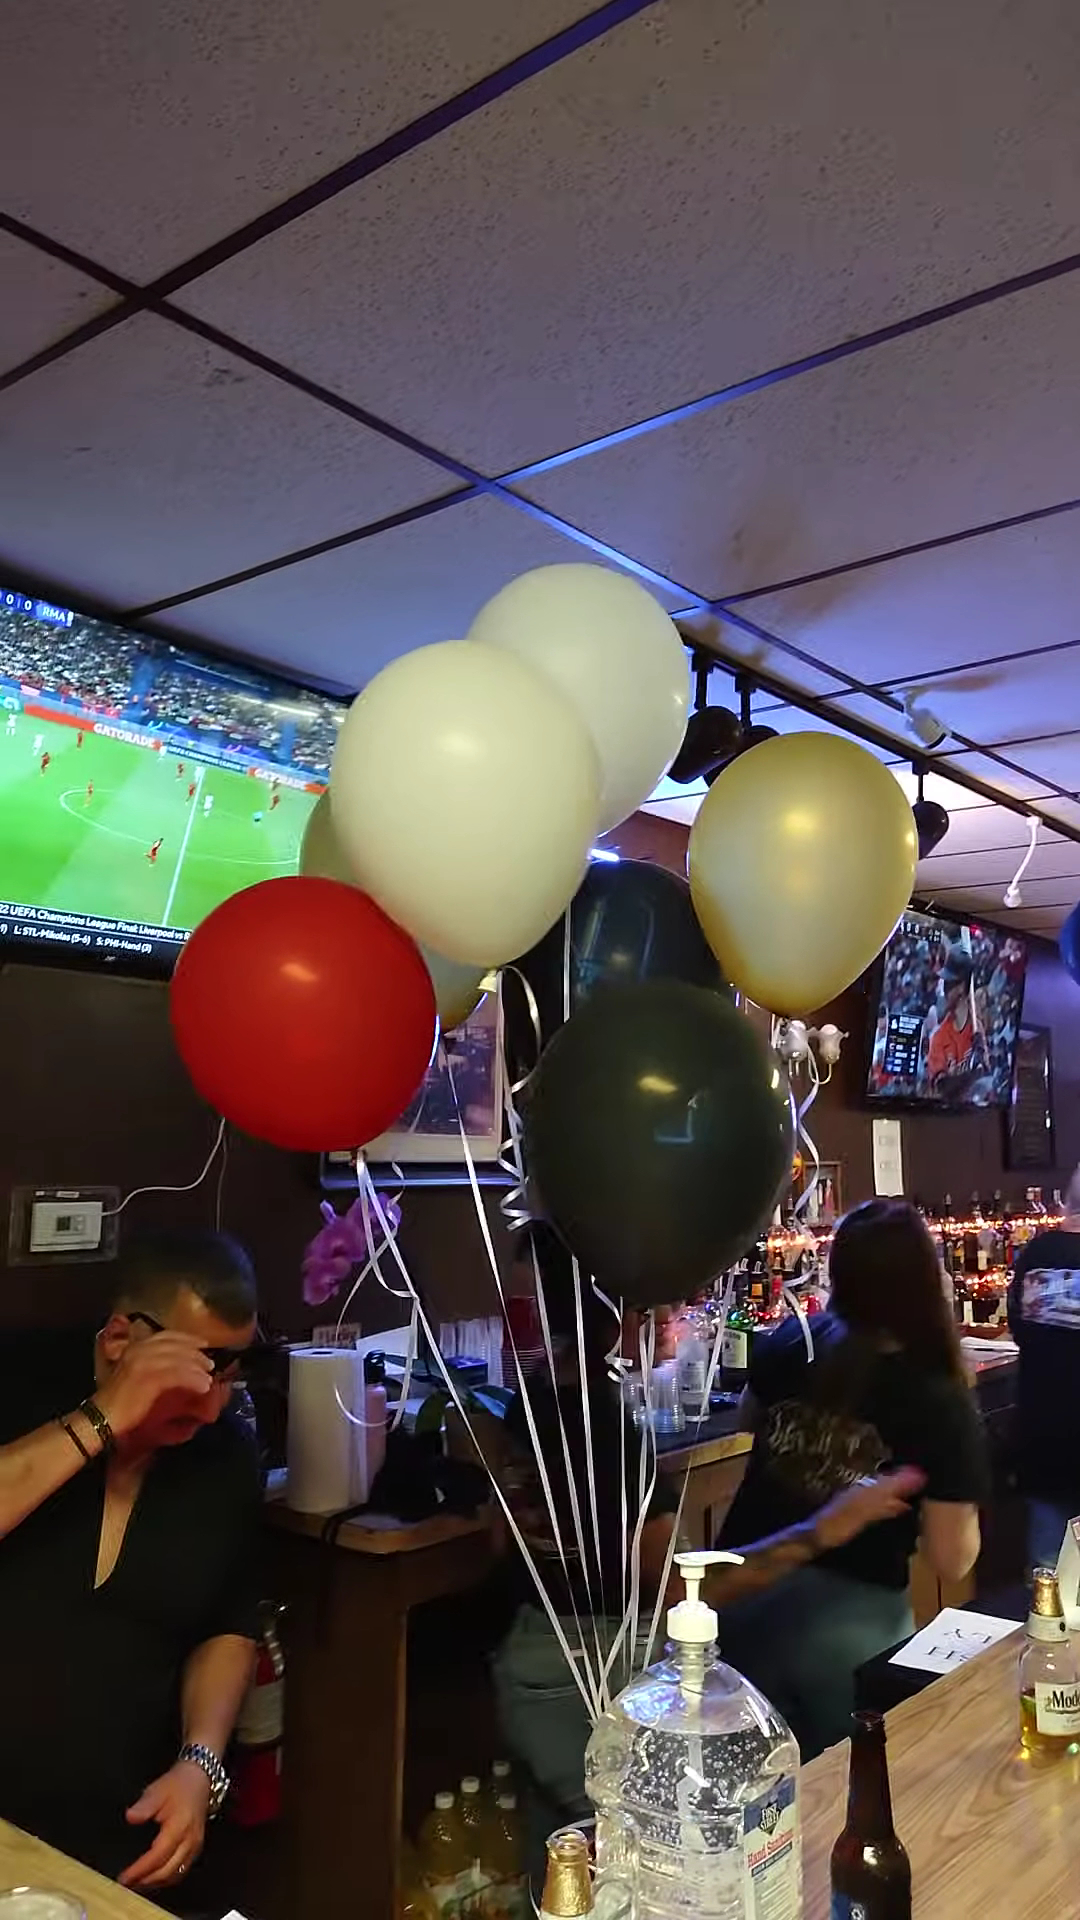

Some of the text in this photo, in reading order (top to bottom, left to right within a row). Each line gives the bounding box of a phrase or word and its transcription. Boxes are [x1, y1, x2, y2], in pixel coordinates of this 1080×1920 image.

[6, 593, 66, 622] 0 0 RMA
[93, 722, 156, 748] GATORADE
[10, 905, 37, 919] UEFA
[37, 909, 86, 926] Champions
[86, 917, 117, 930] League
[139, 925, 175, 939] Liverpool
[175, 932, 184, 940] vs
[71, 933, 91, 946] (5-6)
[104, 938, 141, 951] PHI-Hand
[1052, 1689, 1080, 1709] Mod
